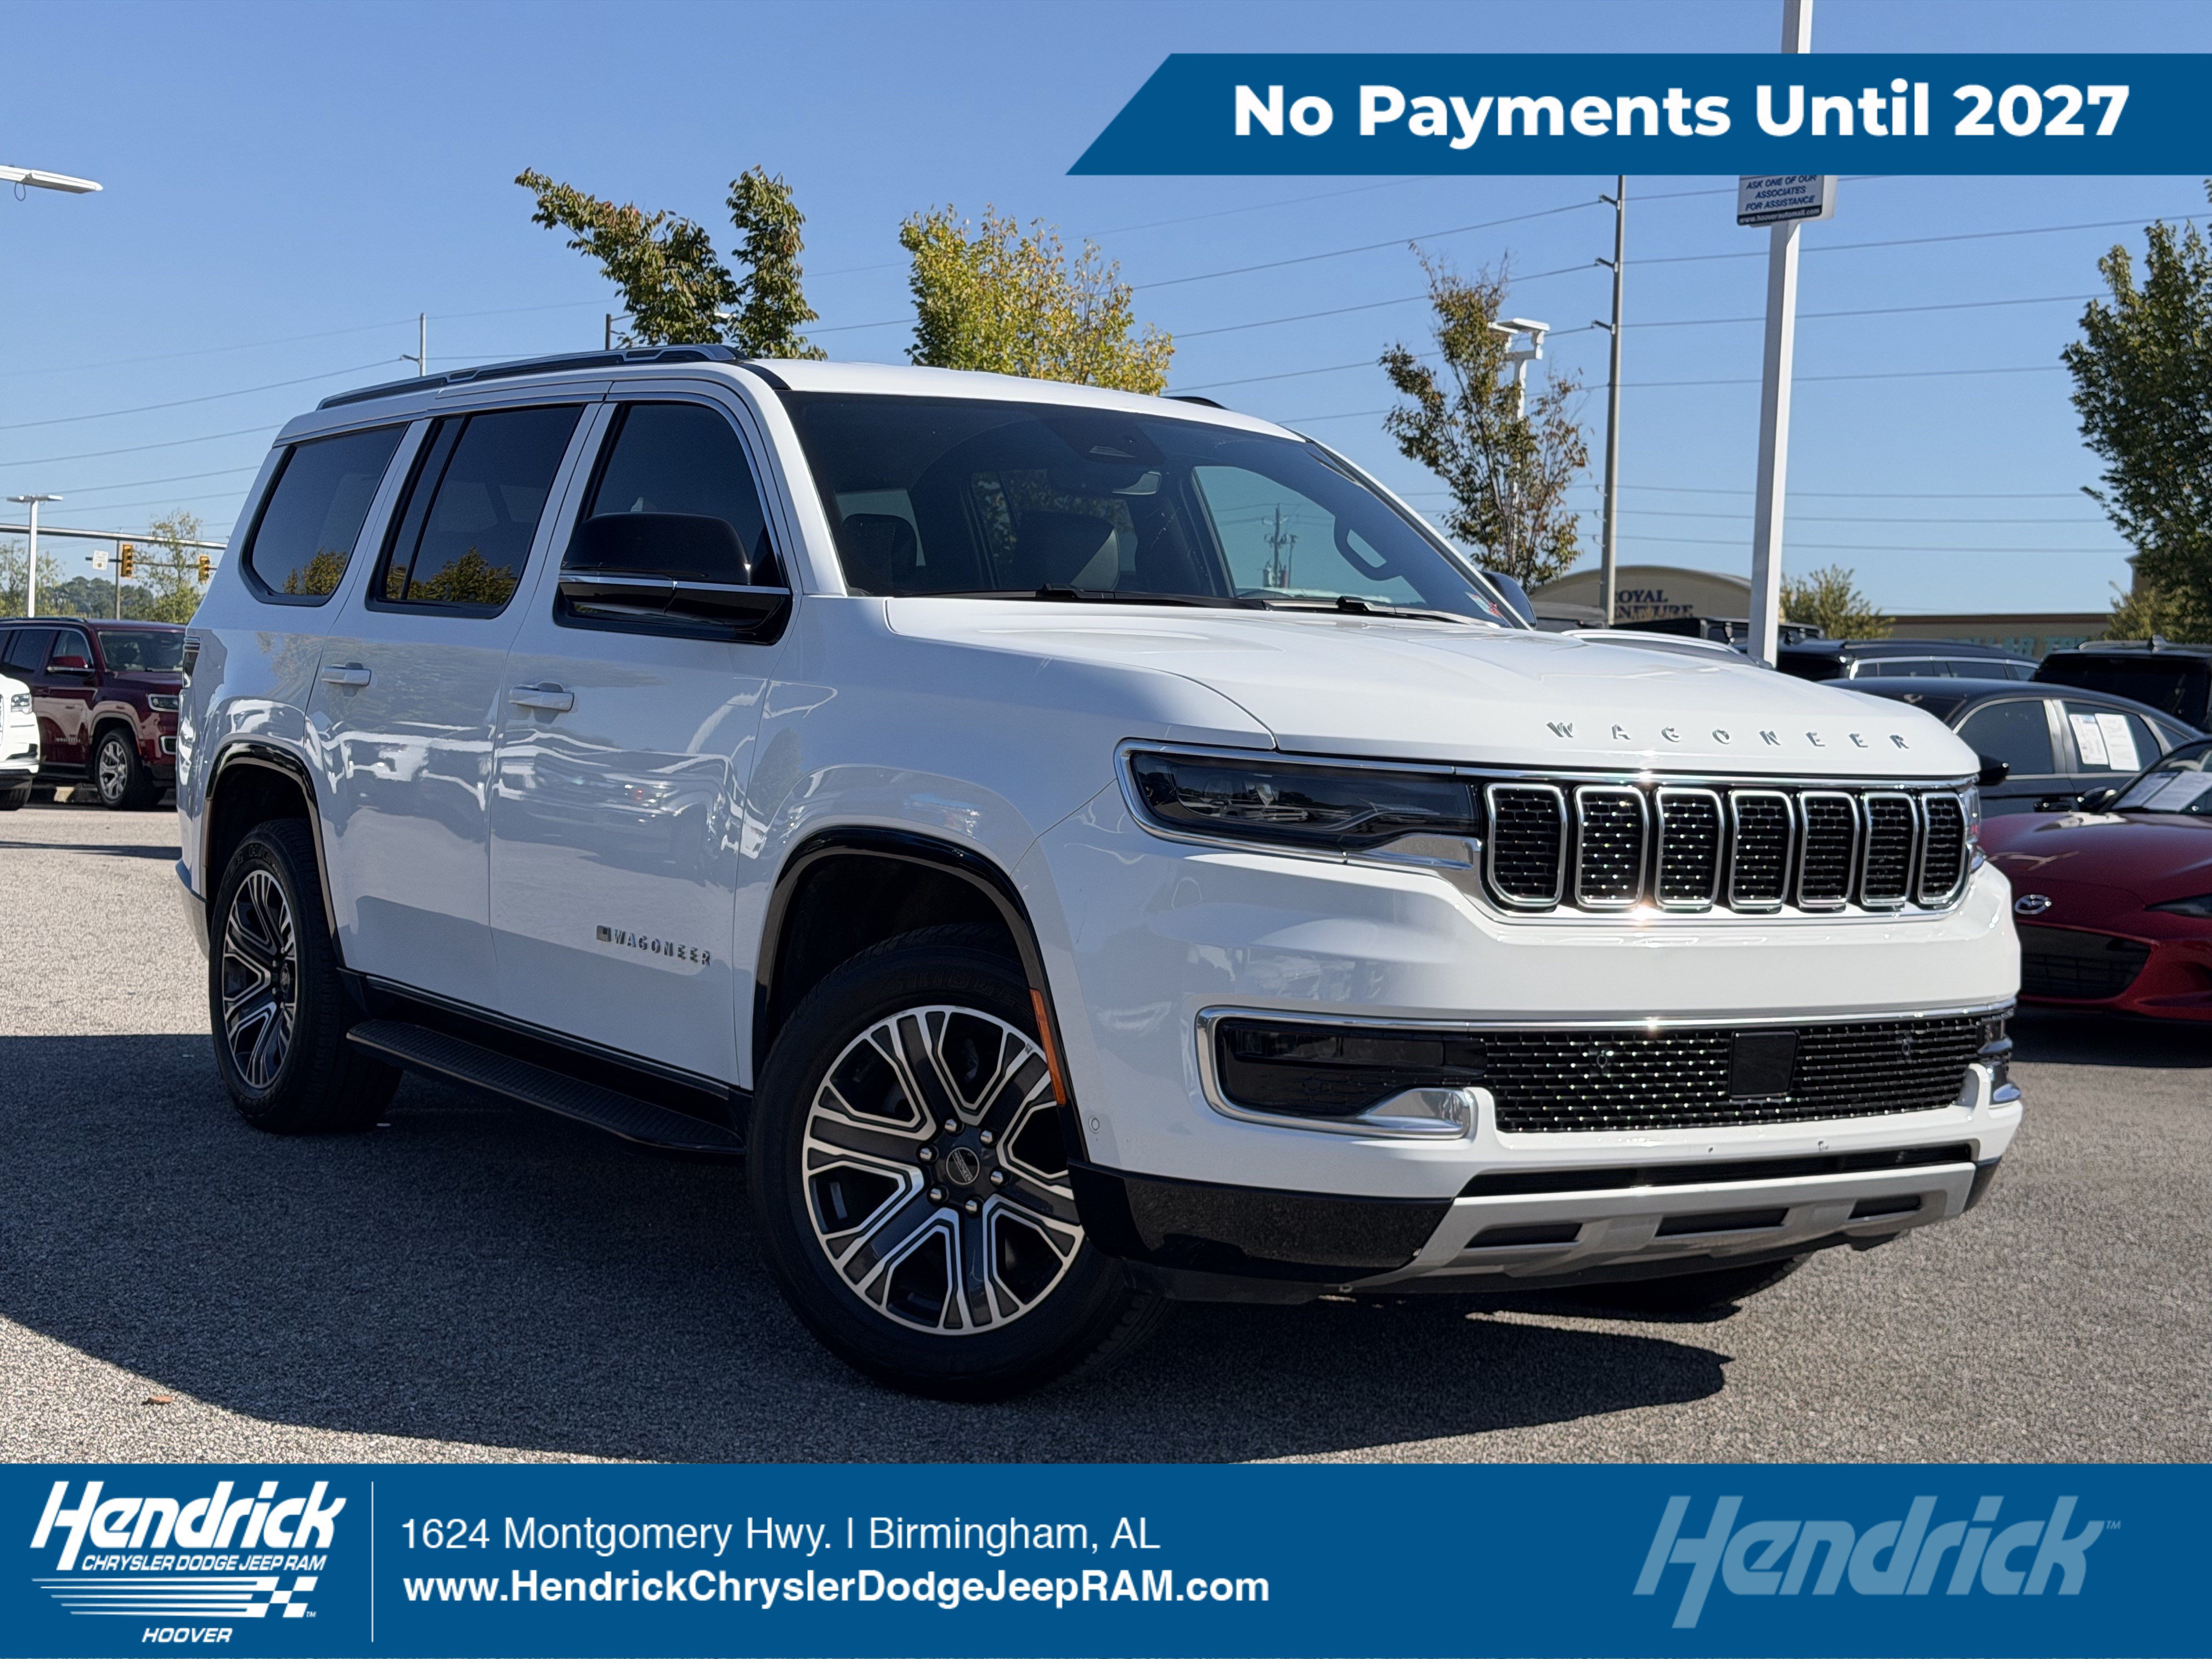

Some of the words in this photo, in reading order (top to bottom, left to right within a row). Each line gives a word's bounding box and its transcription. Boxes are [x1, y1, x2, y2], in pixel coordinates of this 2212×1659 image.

[1746, 179, 1763, 189] ASK
[1765, 177, 1783, 187] ONE
[1785, 176, 1797, 185] OF
[1798, 175, 1817, 183] OUR
[1754, 185, 1806, 200] ASSOCIATES
[1745, 202, 1763, 212] FOR
[1764, 195, 1815, 210] ASSISTANCE
[1615, 590, 1668, 603] OYAL
[1545, 721, 1910, 750] WAGONEER
[614, 928, 711, 967] WAGONEER
